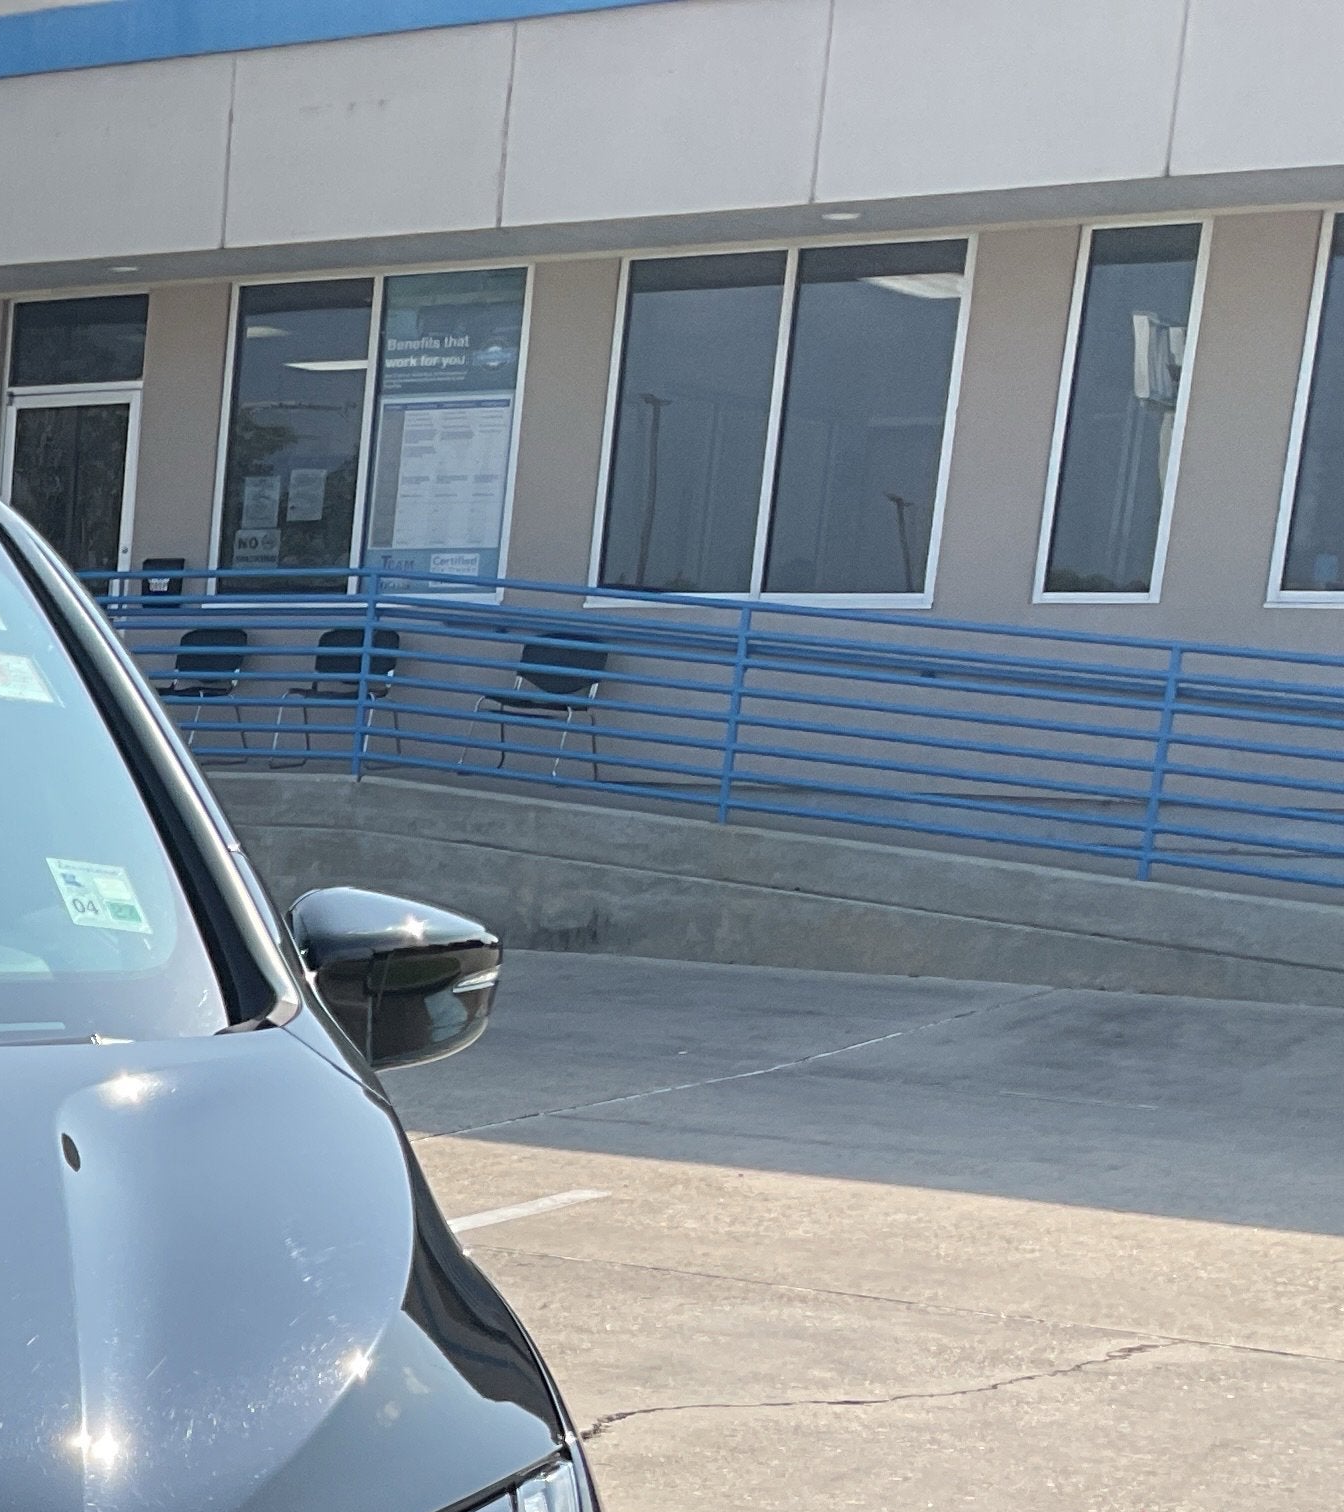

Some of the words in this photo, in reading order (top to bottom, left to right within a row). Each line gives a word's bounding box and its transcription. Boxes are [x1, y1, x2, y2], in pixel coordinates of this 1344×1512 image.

[387, 336, 441, 351] Benefits
[444, 335, 470, 348] that
[385, 356, 417, 368] work
[420, 355, 441, 366] for
[442, 355, 466, 369] you
[72, 898, 99, 915] 04
